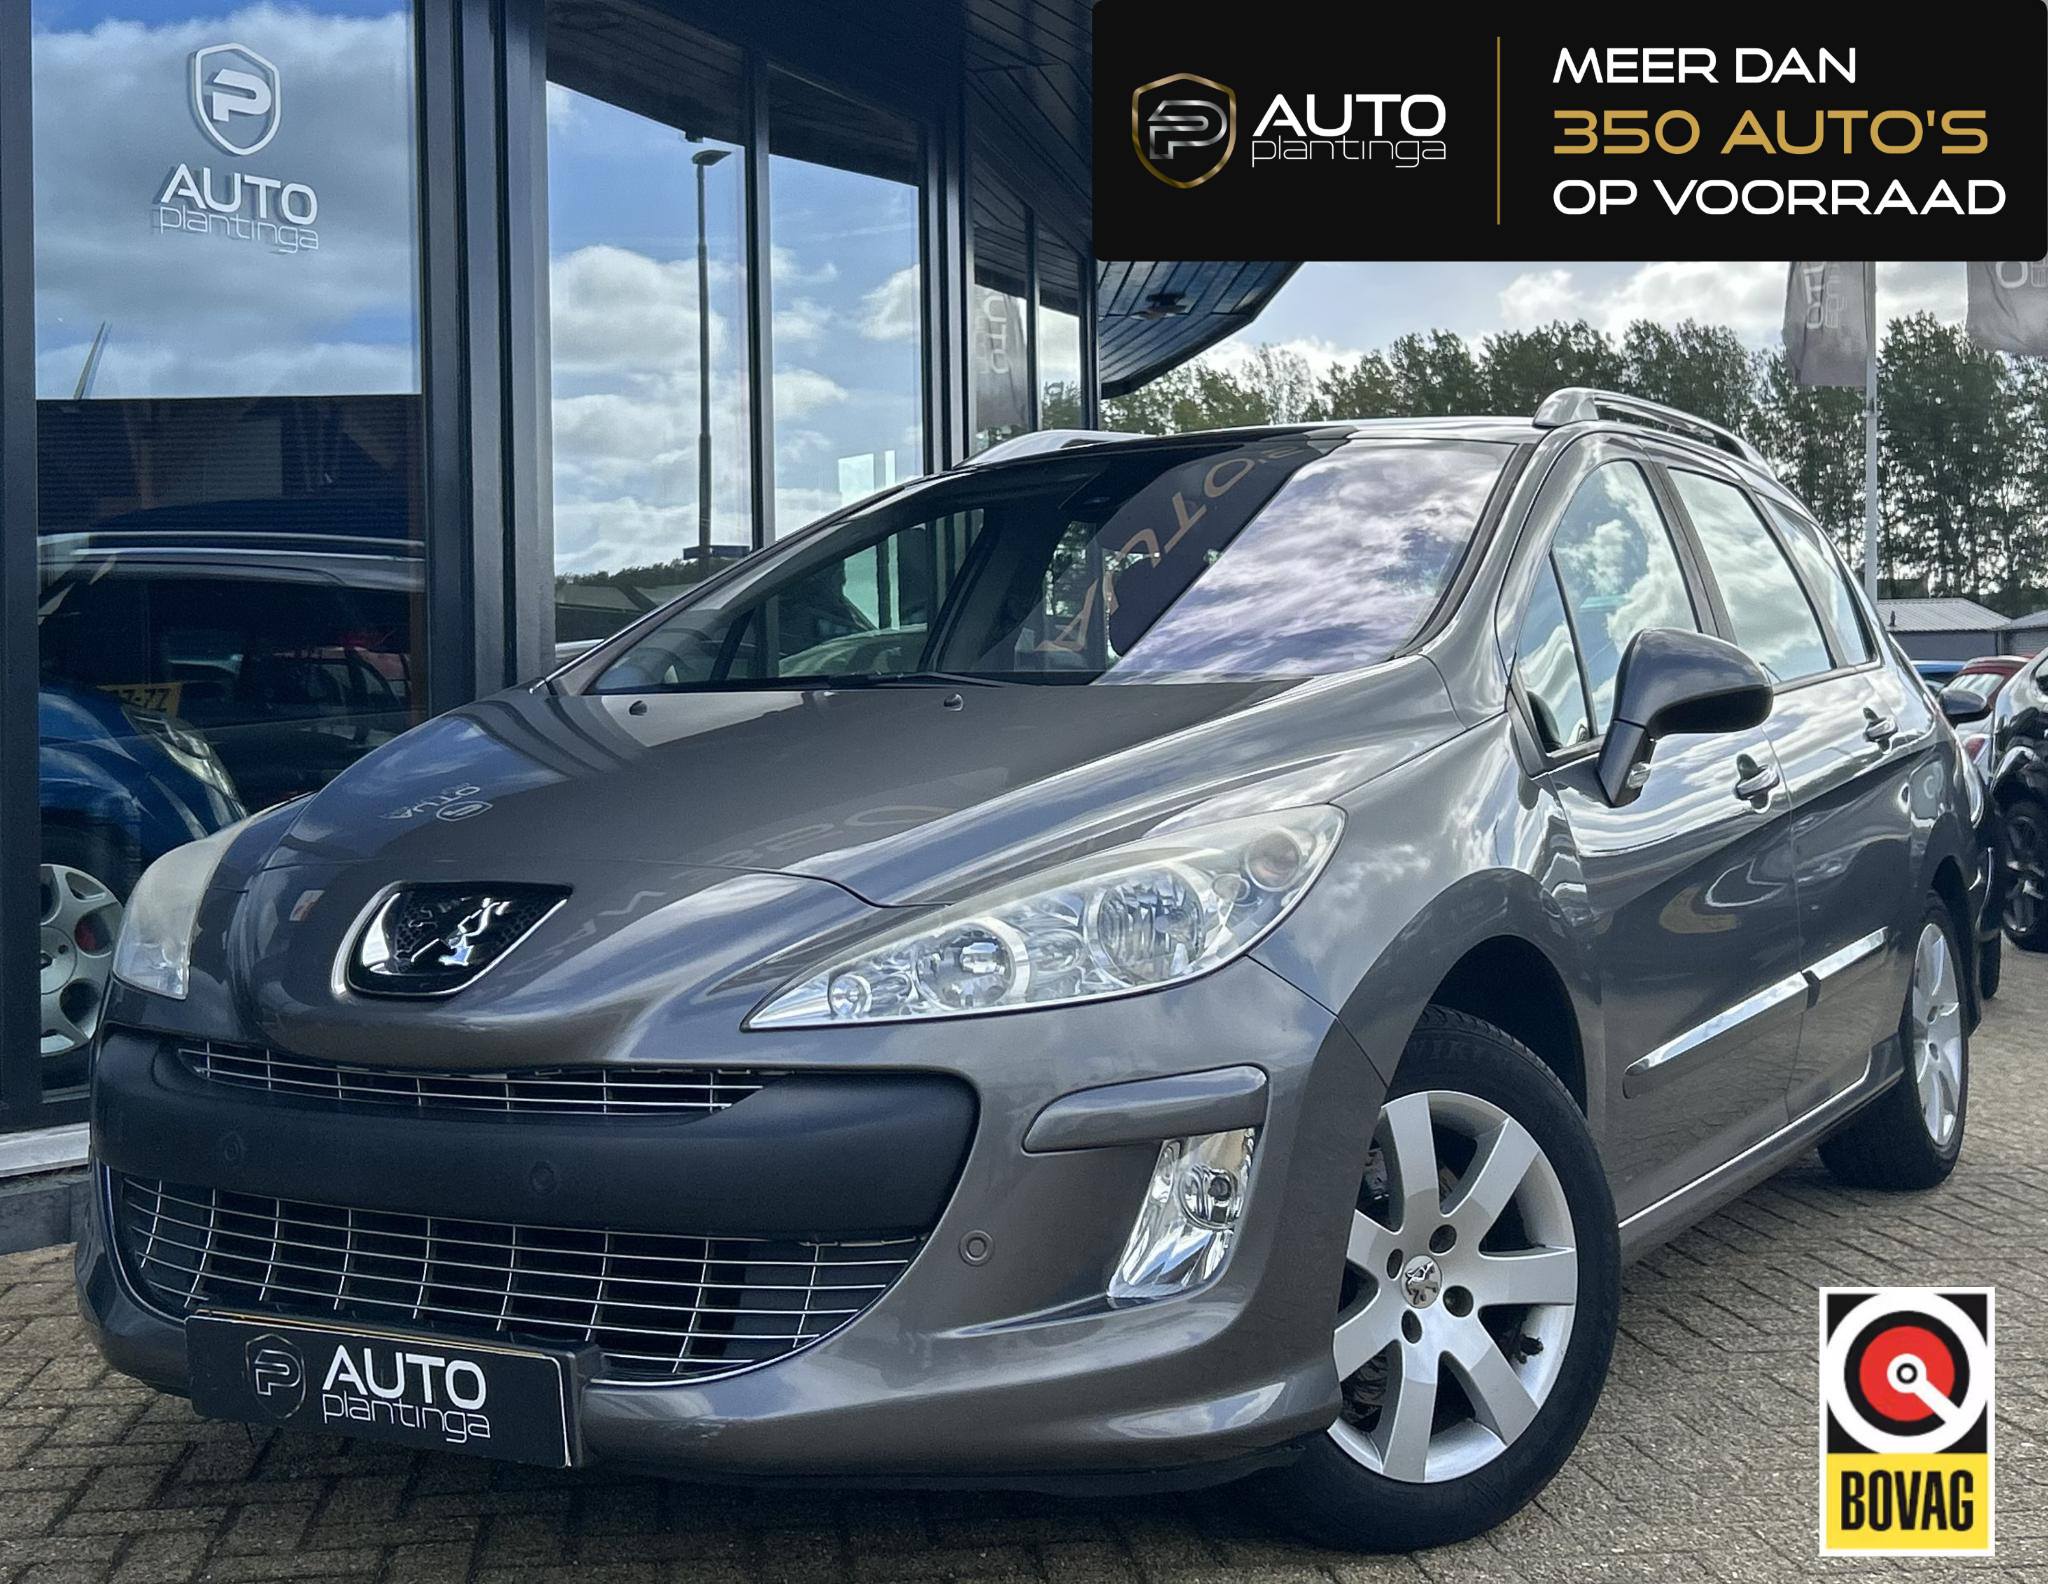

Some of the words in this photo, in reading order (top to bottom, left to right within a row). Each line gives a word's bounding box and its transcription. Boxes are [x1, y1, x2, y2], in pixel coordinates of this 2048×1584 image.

[160, 163, 318, 225] AUTO
[160, 205, 318, 254] plantinga
[322, 1345, 487, 1410] AUTO
[322, 1390, 491, 1443] plantinga
